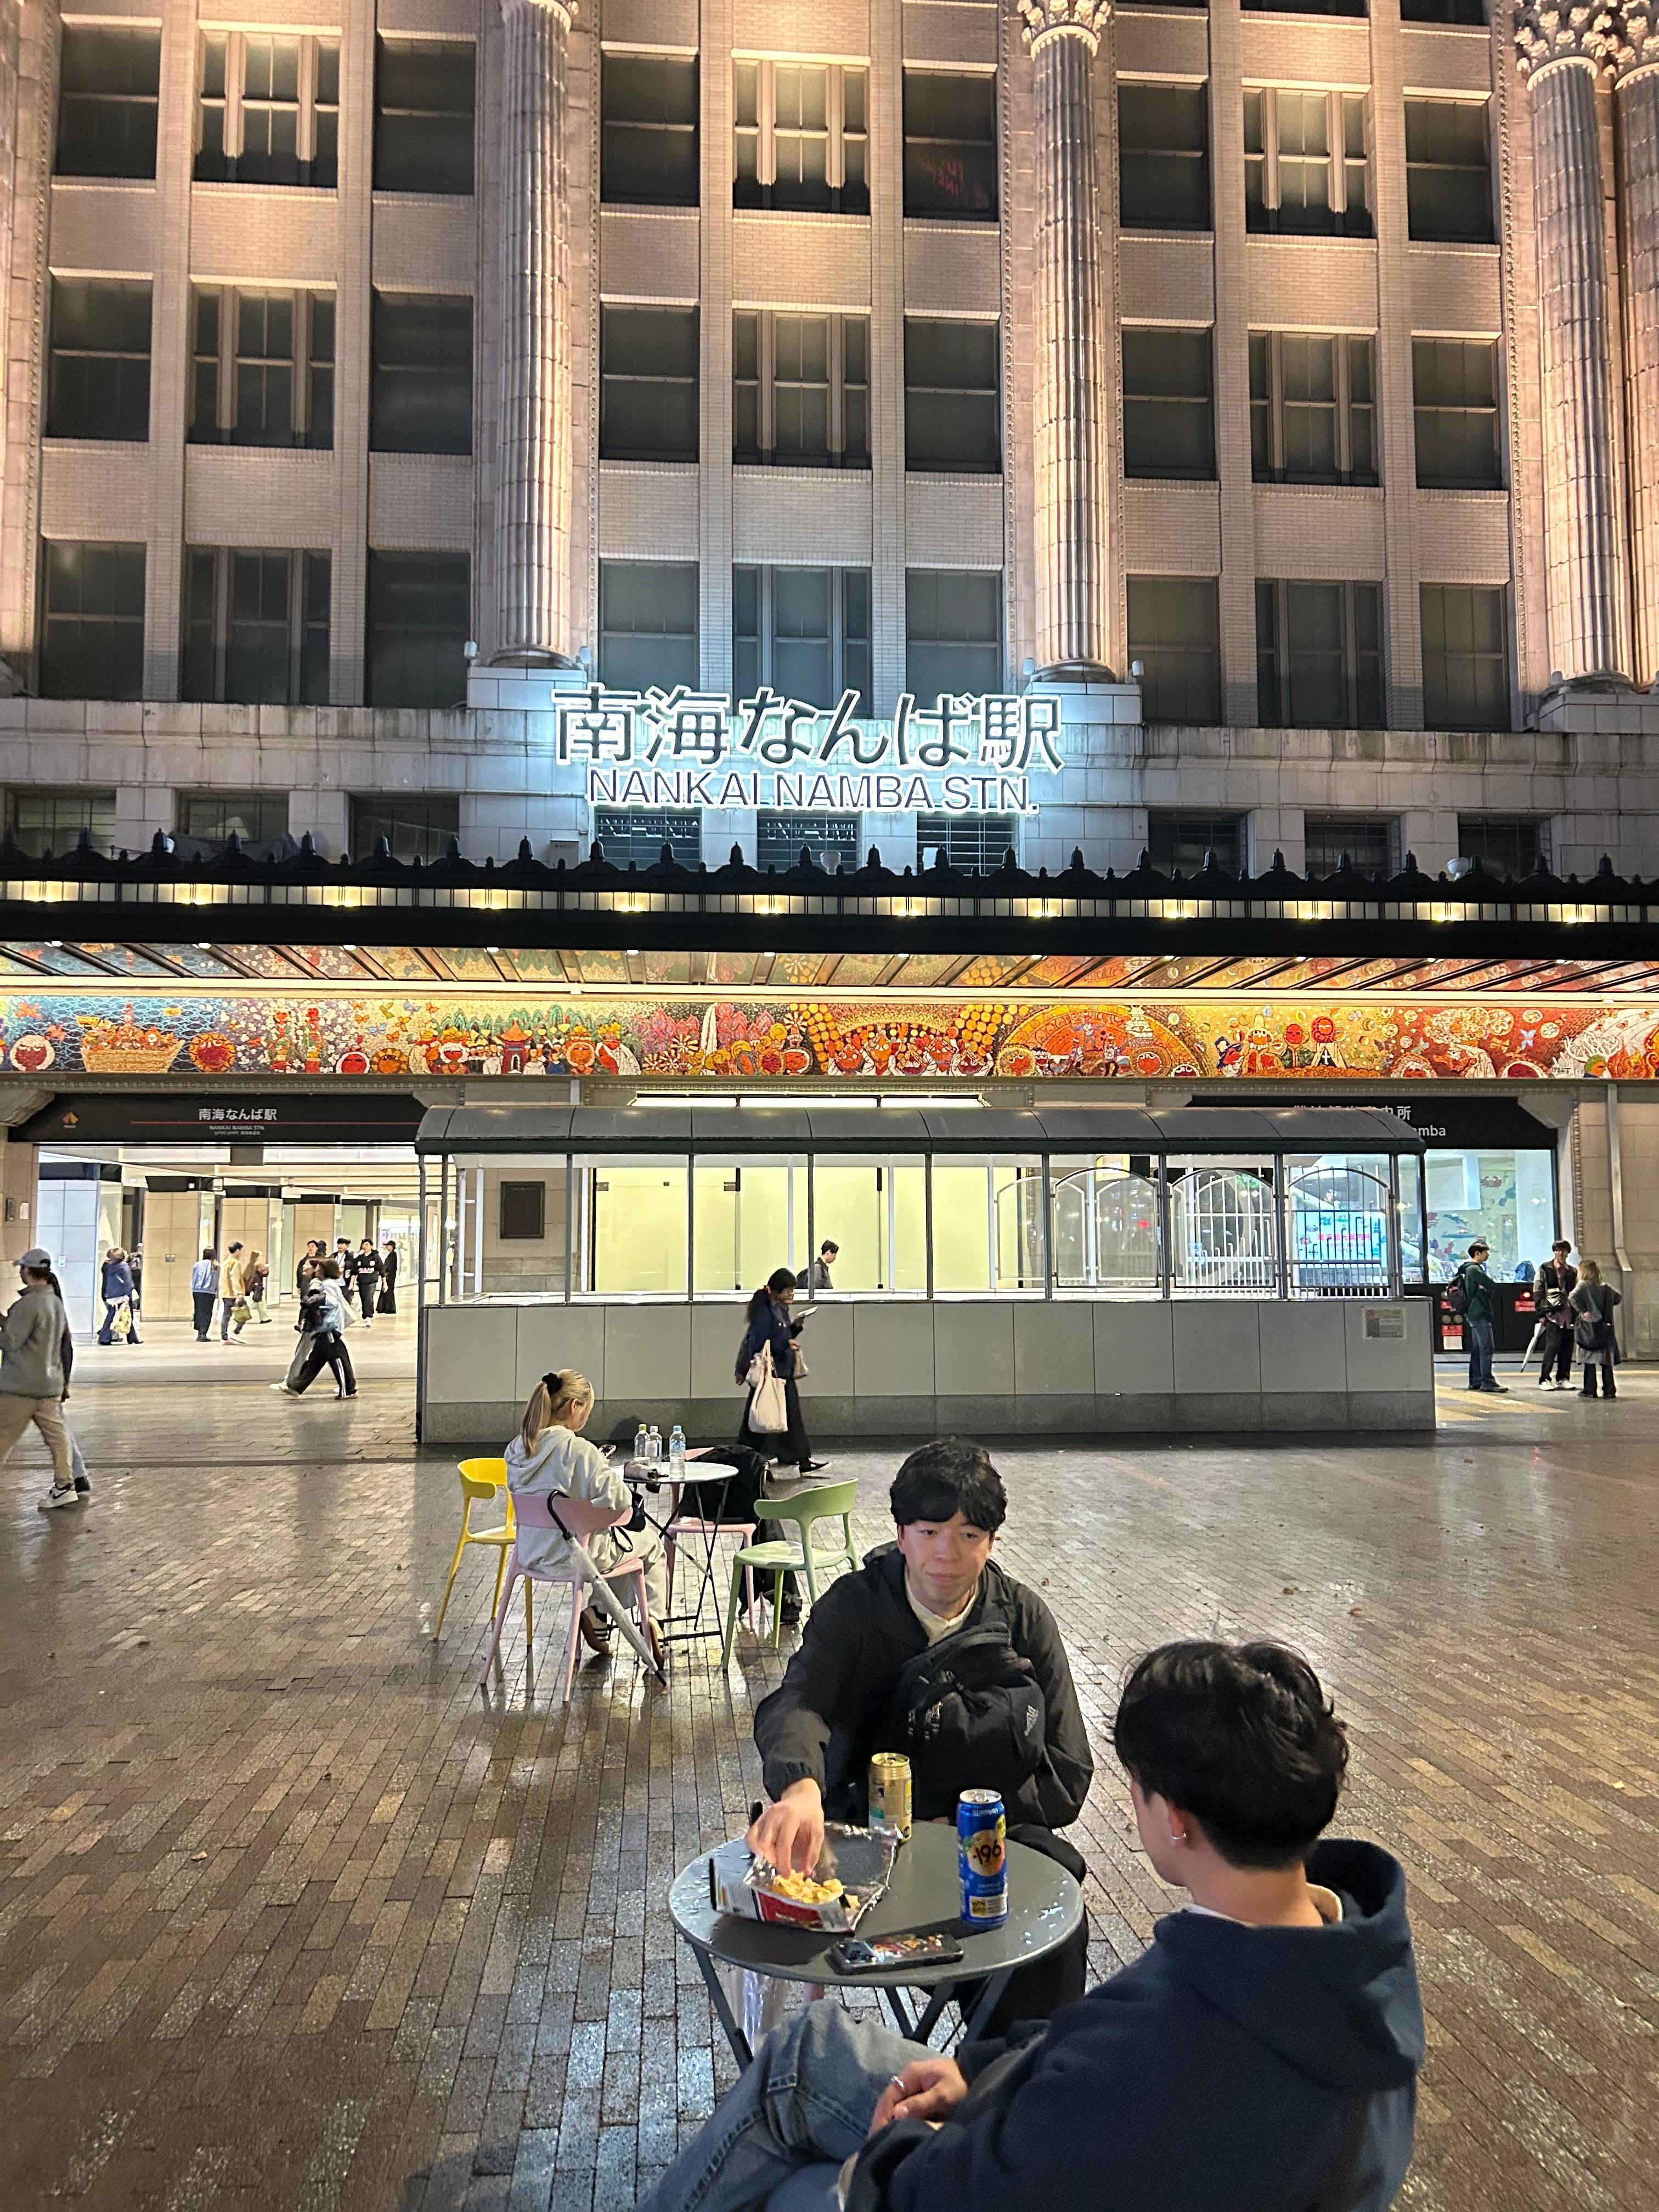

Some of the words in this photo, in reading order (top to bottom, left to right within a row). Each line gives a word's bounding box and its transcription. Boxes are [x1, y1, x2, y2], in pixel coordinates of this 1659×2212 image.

[552, 684, 1064, 771] 南海なんば駅
[589, 768, 759, 807] NANKAI
[775, 772, 934, 810] NAMBA
[943, 774, 1039, 811] STN.
[199, 1108, 277, 1120] 南海なんば駅
[1413, 1125, 1446, 1136] mba
